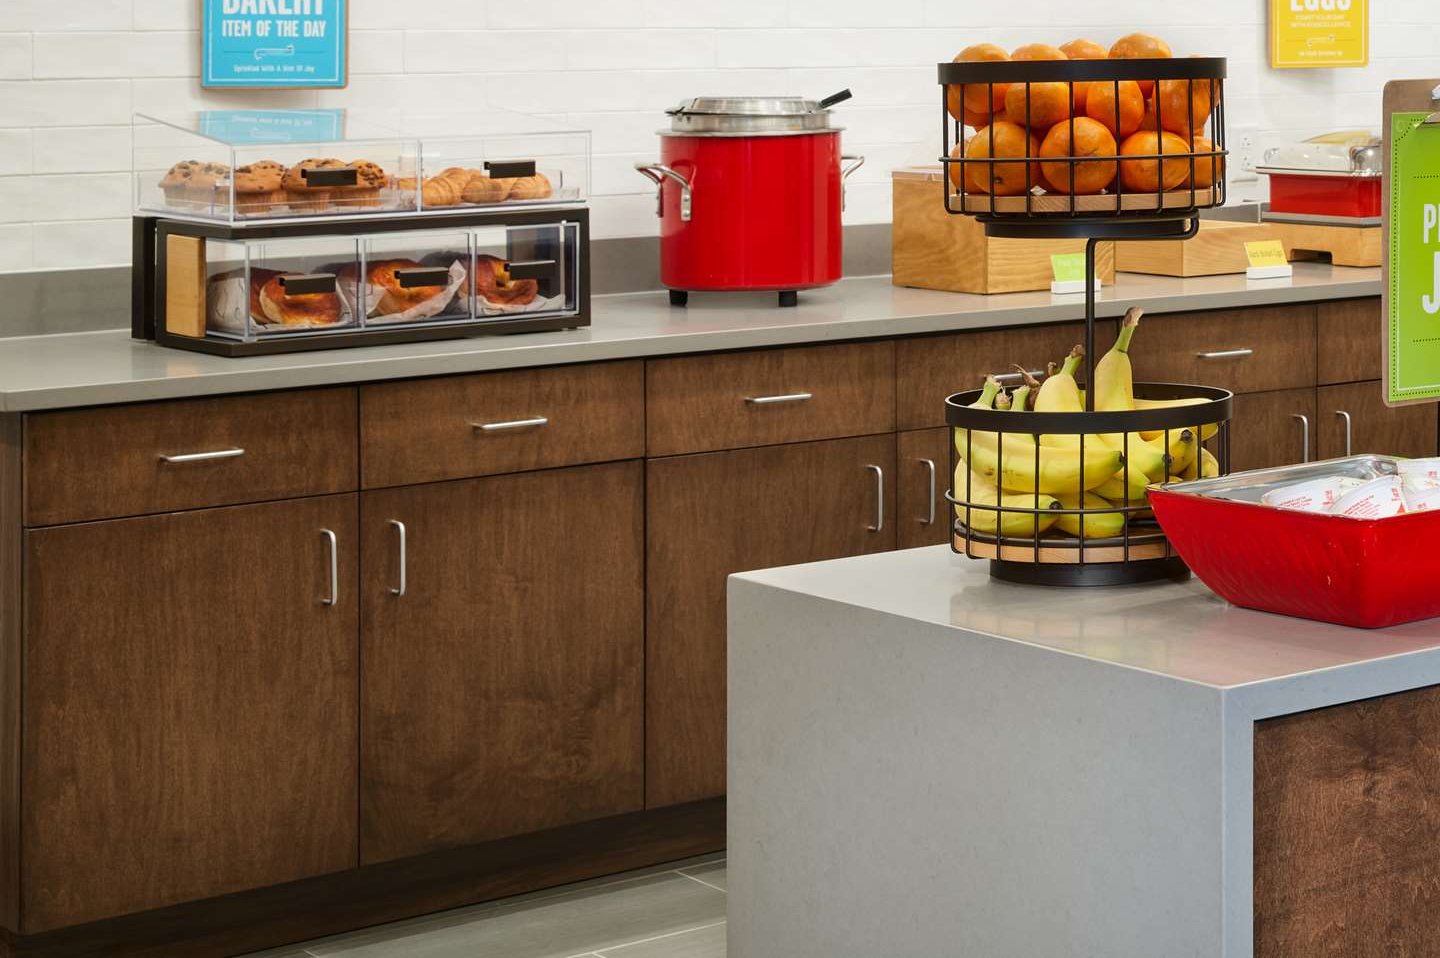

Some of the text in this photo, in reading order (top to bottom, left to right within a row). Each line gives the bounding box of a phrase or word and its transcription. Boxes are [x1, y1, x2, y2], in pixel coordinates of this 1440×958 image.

[222, 19, 327, 38] ITEM OF THE DAY
